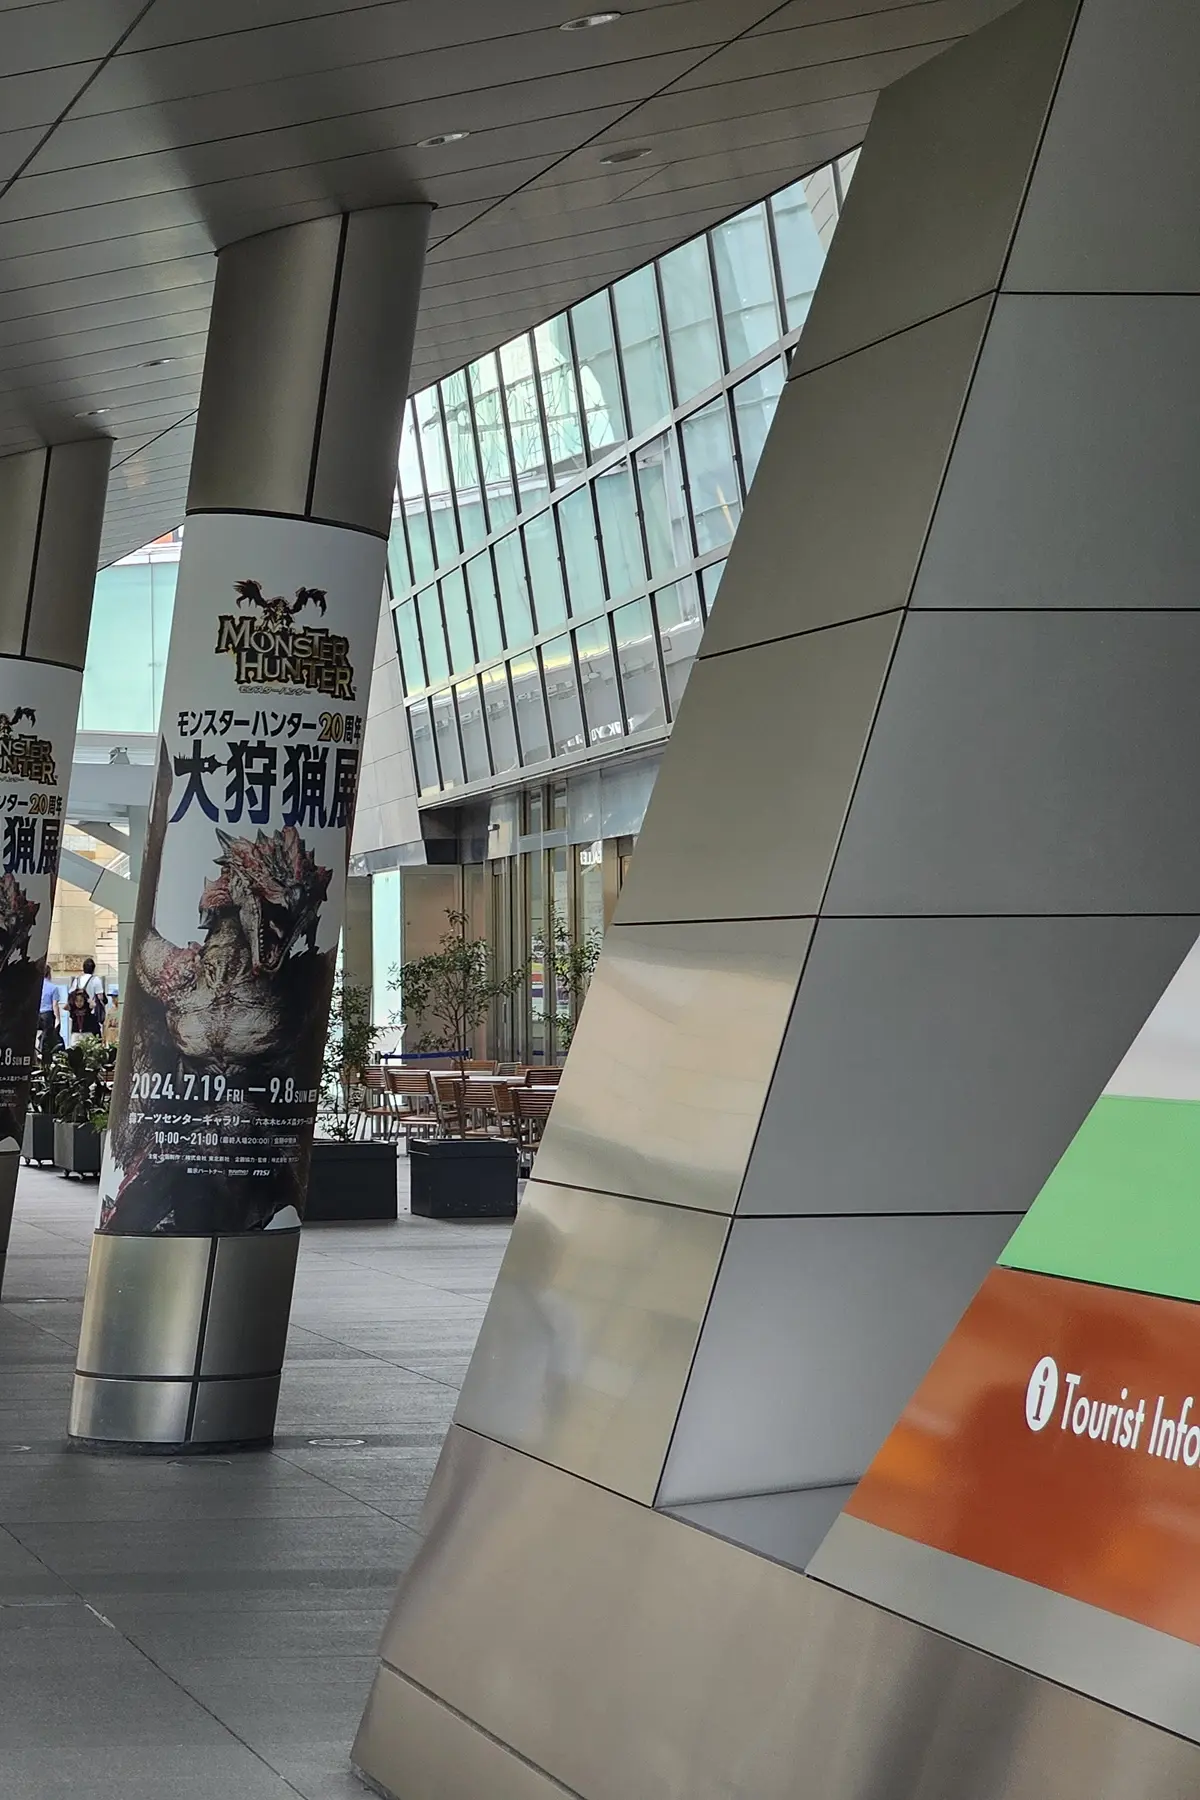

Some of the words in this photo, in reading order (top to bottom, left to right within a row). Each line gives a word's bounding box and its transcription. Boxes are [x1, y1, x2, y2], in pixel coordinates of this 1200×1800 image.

[215, 615, 349, 668] MONSTER
[236, 648, 355, 700] HUNTER
[177, 709, 363, 745] モンスターハンター20周年
[1061, 1372, 1145, 1450] Tourist
[1148, 1395, 1200, 1468] Info
